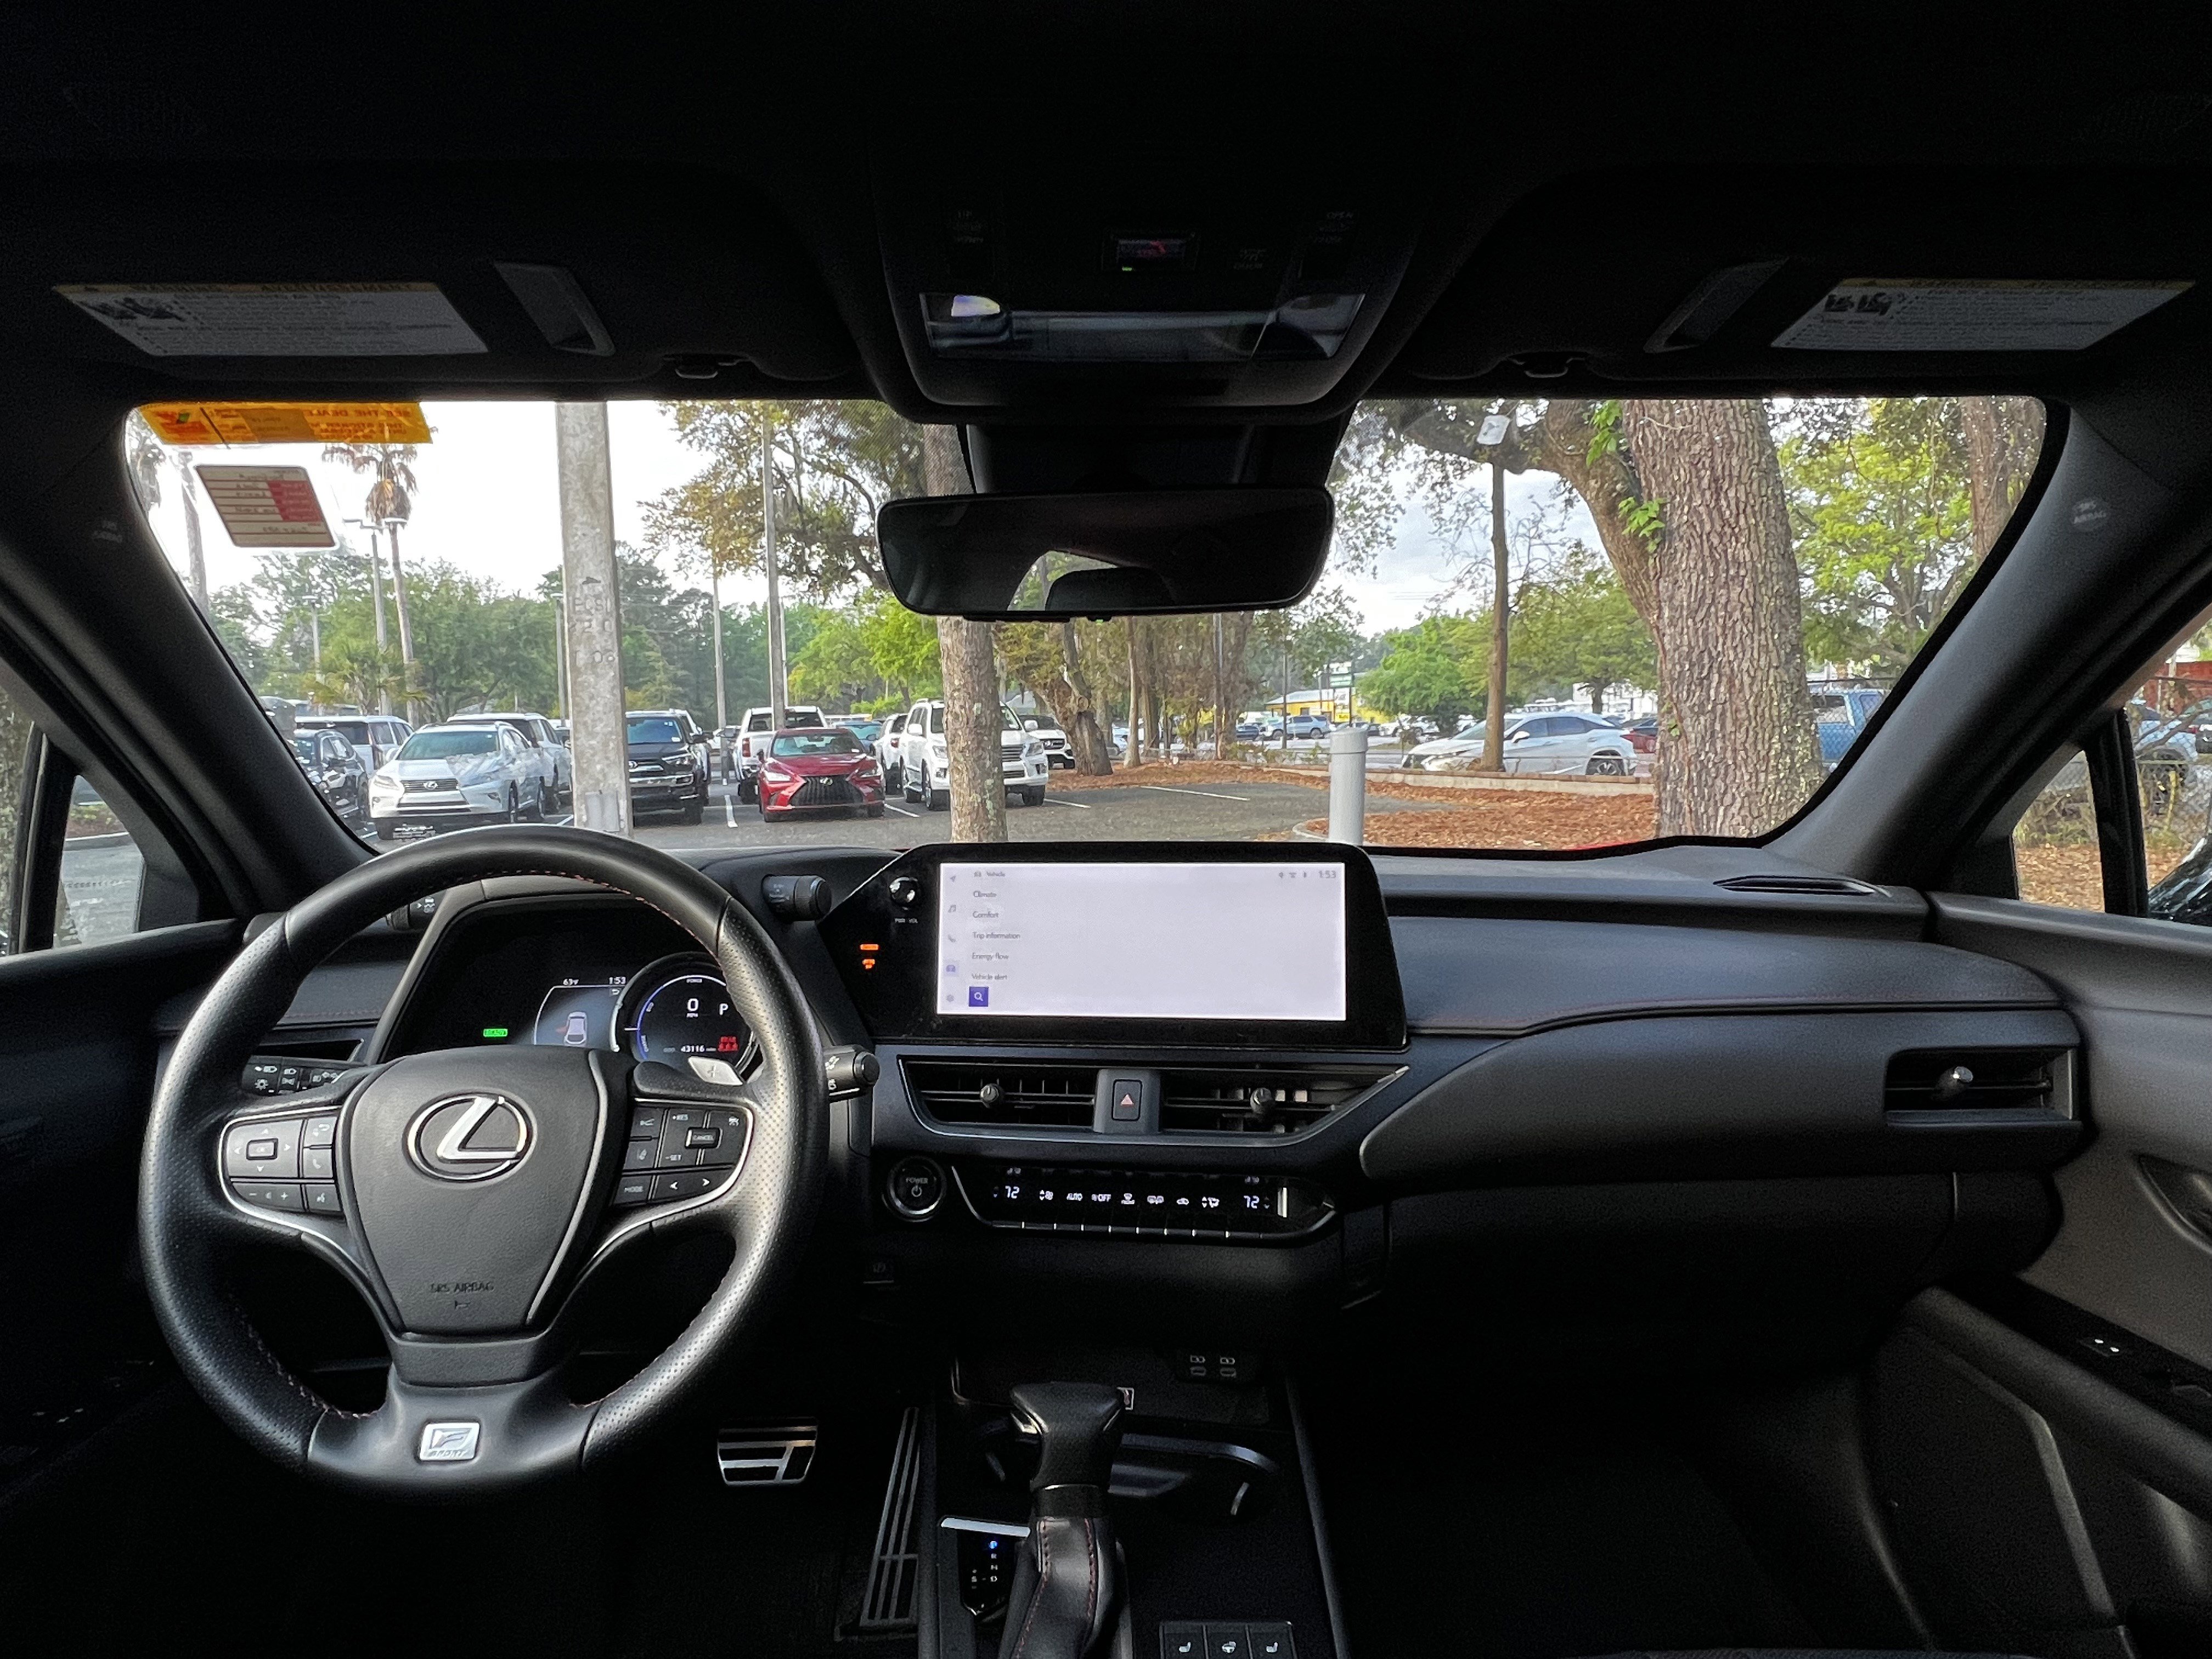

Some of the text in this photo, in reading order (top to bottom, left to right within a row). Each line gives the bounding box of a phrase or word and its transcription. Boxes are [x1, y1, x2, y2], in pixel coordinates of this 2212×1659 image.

[972, 952, 1009, 961] Energy flow
[687, 998, 699, 1012] 0
[719, 1003, 729, 1015] P
[1005, 1185, 1020, 1199] 72
[1243, 1195, 1260, 1209] 72
